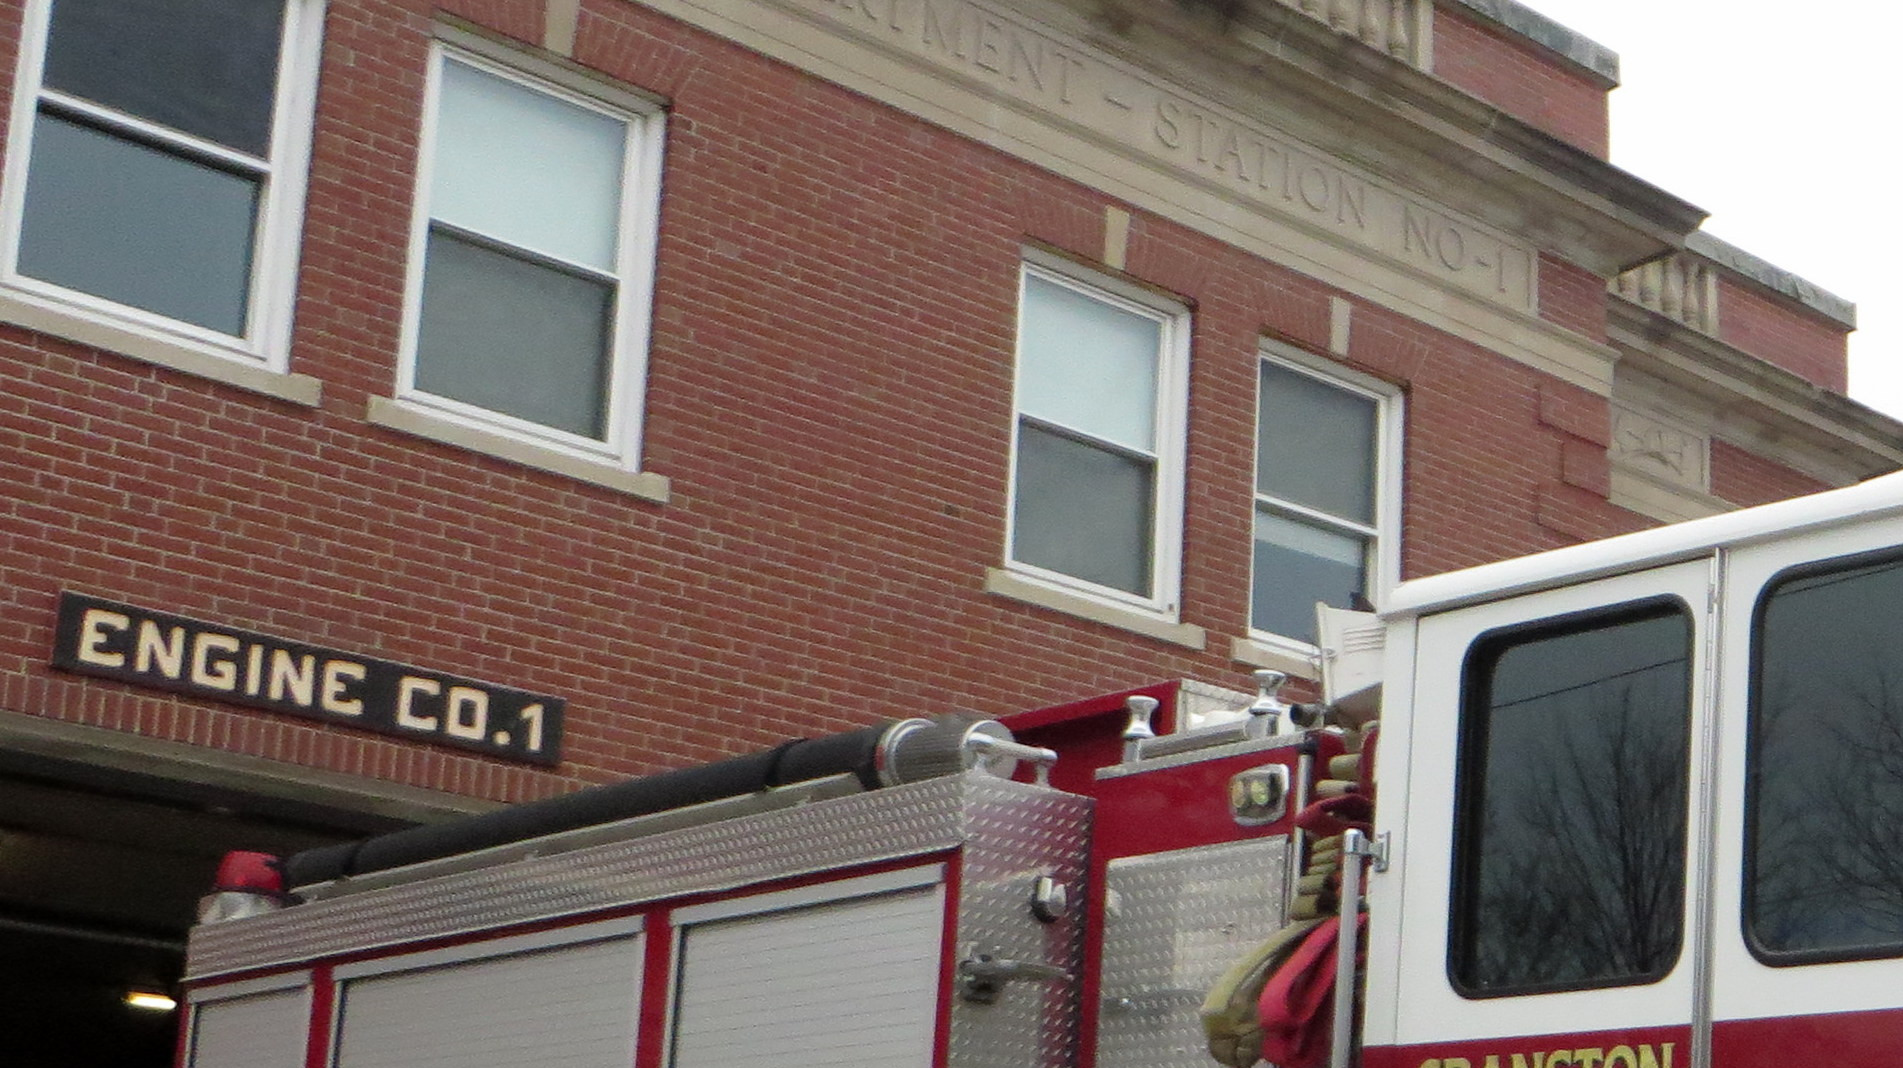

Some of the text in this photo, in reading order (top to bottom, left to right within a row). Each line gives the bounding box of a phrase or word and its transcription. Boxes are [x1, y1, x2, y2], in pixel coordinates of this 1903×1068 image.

[1154, 99, 1365, 229] STATION
[78, 609, 544, 753] ENGINE CO.1
